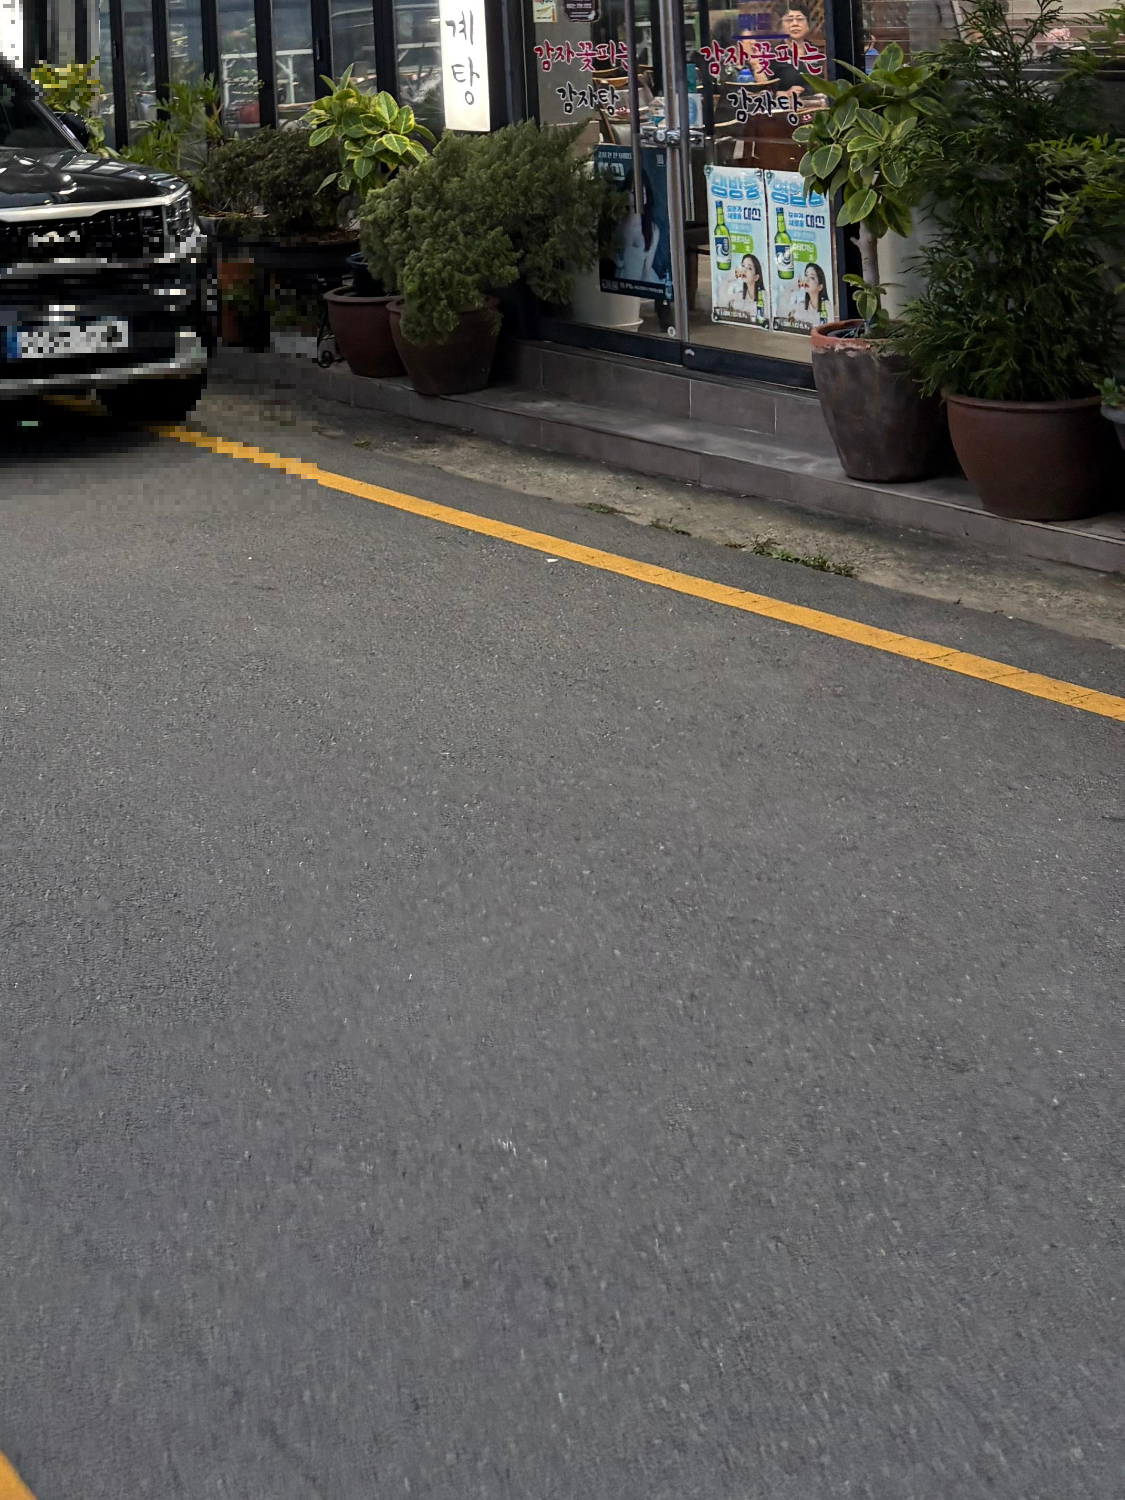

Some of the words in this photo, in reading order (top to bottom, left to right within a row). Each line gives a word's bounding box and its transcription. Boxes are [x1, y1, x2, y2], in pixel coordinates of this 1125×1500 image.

[700, 39, 827, 76] 감자꽃피는
[556, 80, 620, 117] 감자탕
[727, 86, 805, 126] 감자탕
